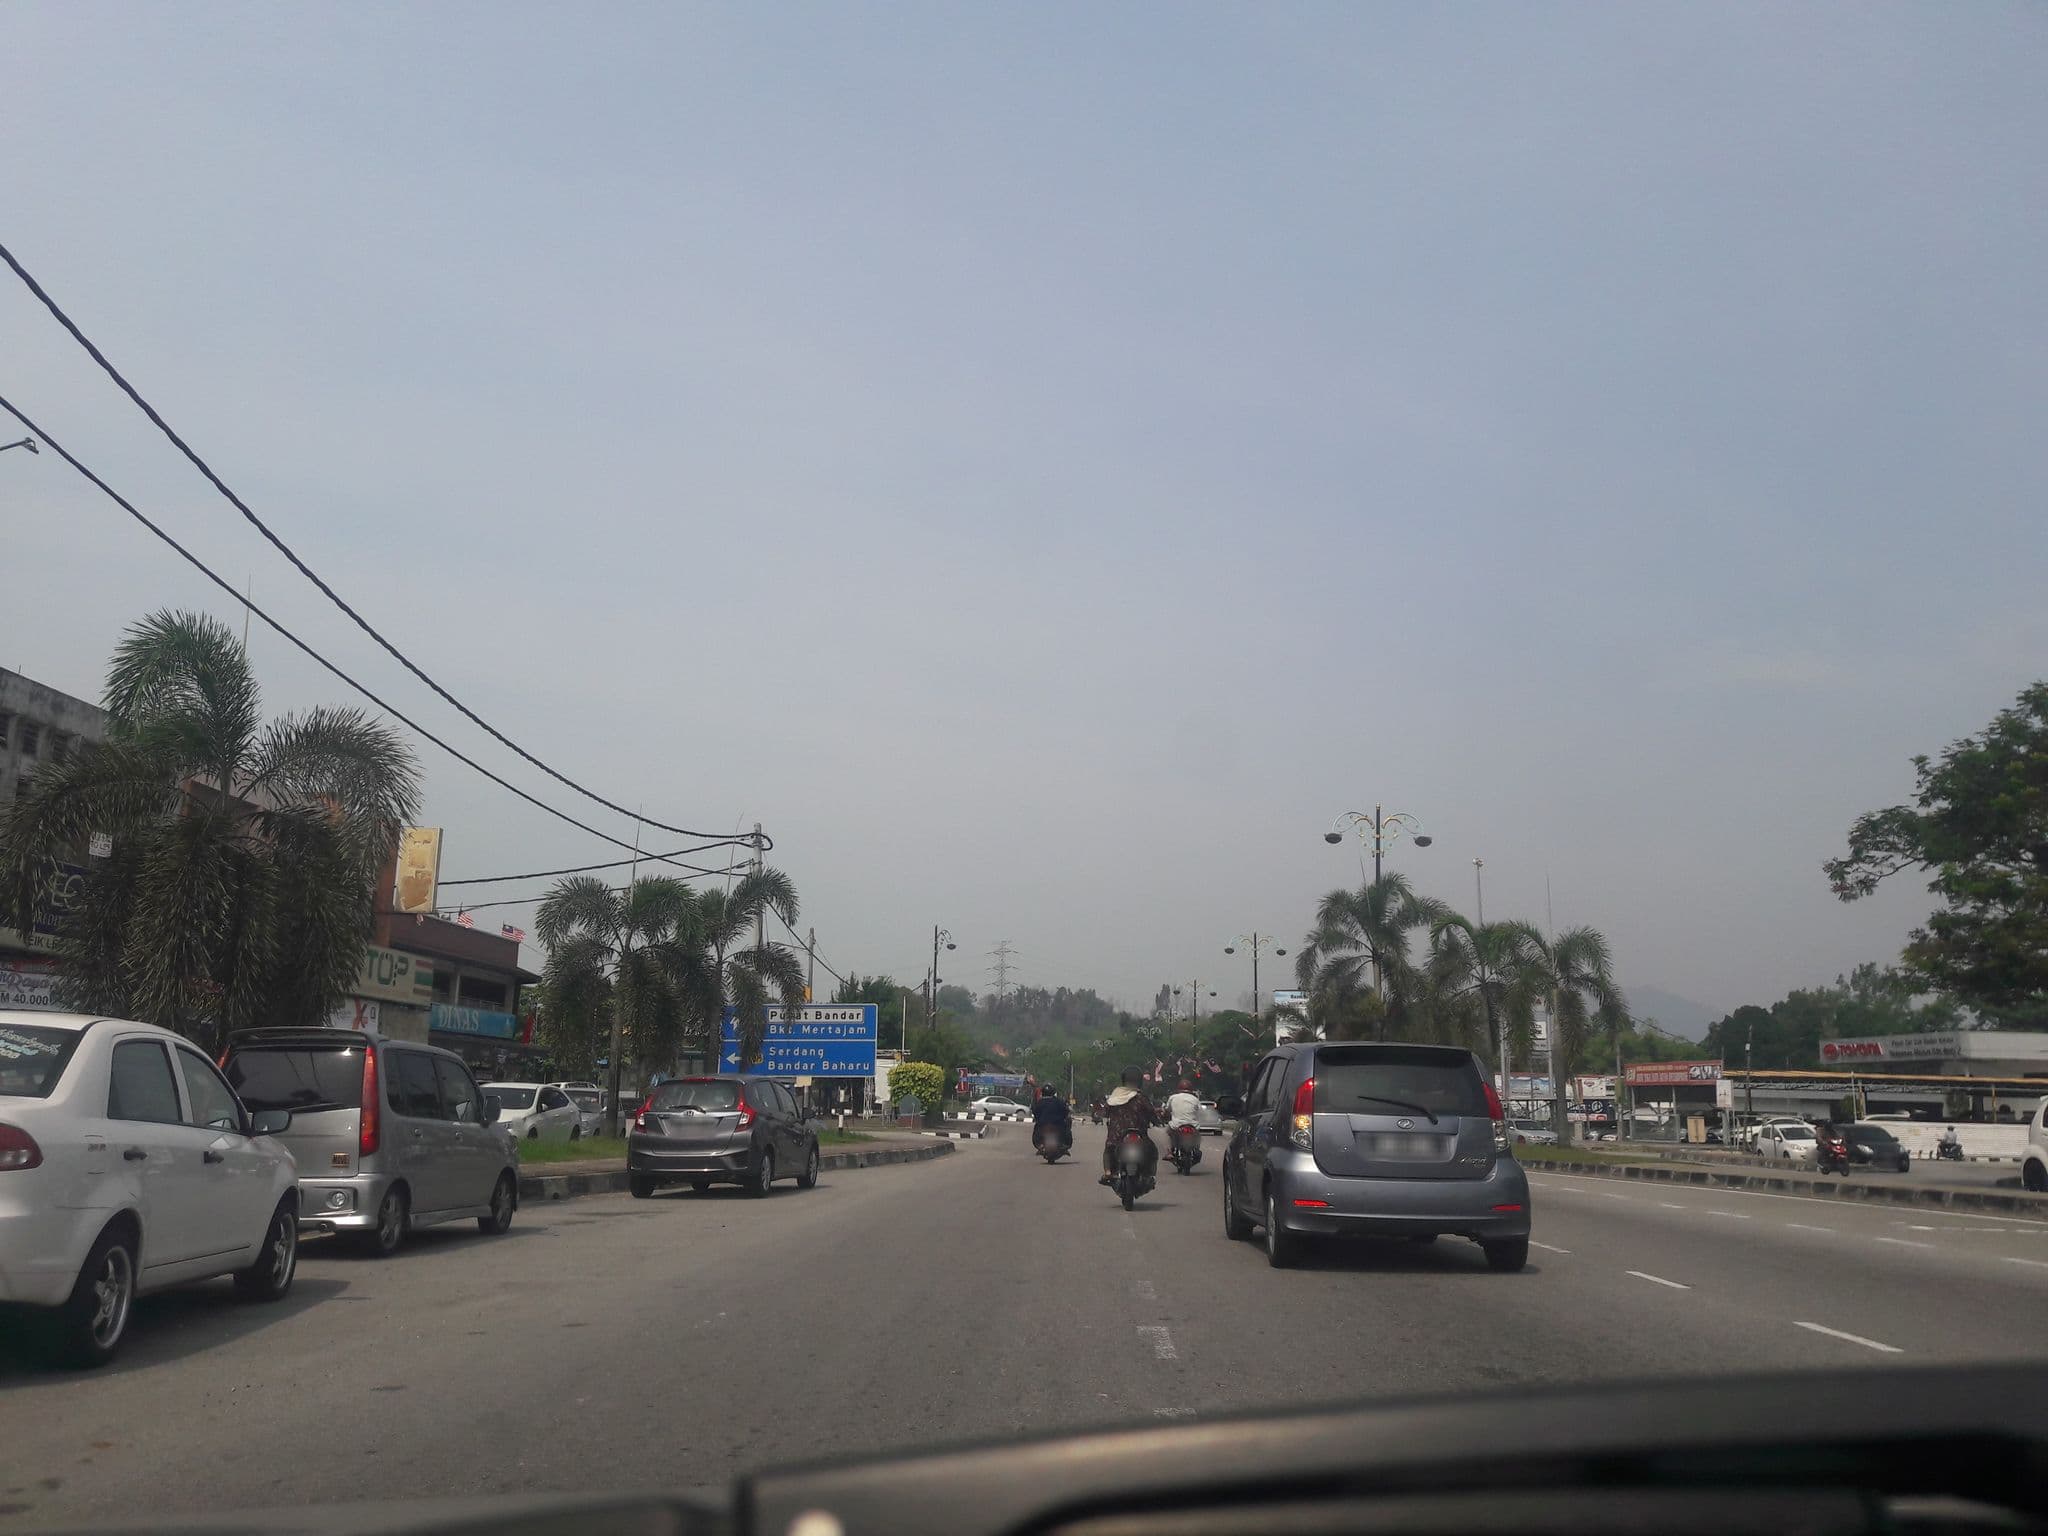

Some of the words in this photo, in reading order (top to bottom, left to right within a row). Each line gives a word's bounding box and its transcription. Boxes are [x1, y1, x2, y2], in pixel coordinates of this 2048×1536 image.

[770, 1010, 808, 1020] Puat
[815, 1010, 861, 1020] Bandar
[801, 1025, 866, 1036] Mertajam
[769, 1047, 824, 1057] Serdang
[768, 1061, 815, 1070] Bandar
[822, 1061, 870, 1070] Baharu
